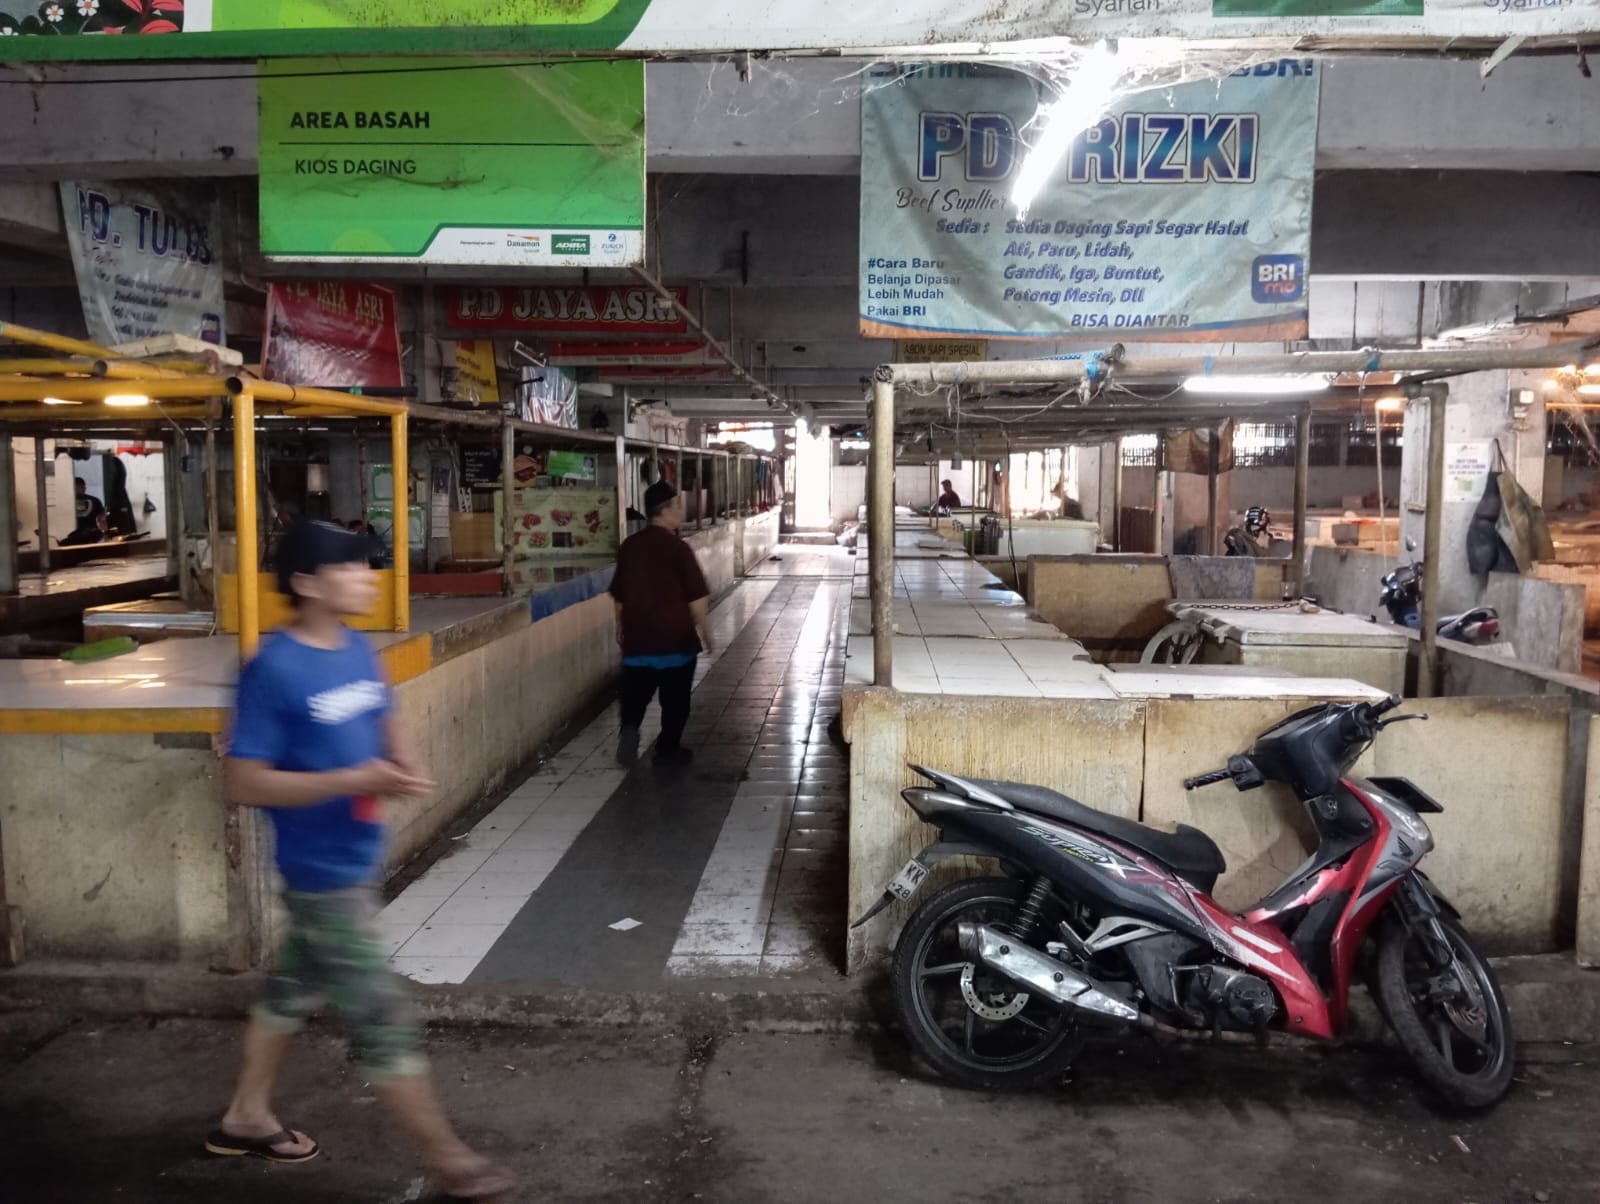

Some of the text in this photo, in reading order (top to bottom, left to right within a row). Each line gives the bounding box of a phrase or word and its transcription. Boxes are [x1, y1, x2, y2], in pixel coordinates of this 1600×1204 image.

[290, 111, 430, 129] AREA BASAH
[1067, 112, 1260, 184] RIZKI
[294, 159, 417, 175] KIOS DAGING
[895, 187, 940, 213] Beef
[935, 218, 980, 234] Sedia
[1005, 218, 1051, 234] Sedia
[1054, 219, 1112, 238] Daging
[1115, 219, 1151, 238] Sapi
[1154, 219, 1203, 238] Segar
[1204, 219, 1250, 236] Halal
[1003, 241, 1135, 260] Ati, Paru, Lidah,
[867, 258, 945, 269] #Cara Baru
[1003, 263, 1165, 282] Gandik, Iga, Buntut,
[867, 274, 961, 287] Belanja Dipasar
[1258, 264, 1295, 282] BRI
[867, 288, 944, 299] Lebih Mudah
[1003, 287, 1145, 305] Potong Mesin, Dll
[1264, 282, 1296, 294] mo
[457, 287, 502, 319] PD
[512, 288, 599, 321] JAYA
[867, 305, 926, 316] Pakai BRI
[1071, 313, 1190, 328] BISA DIANTAR
